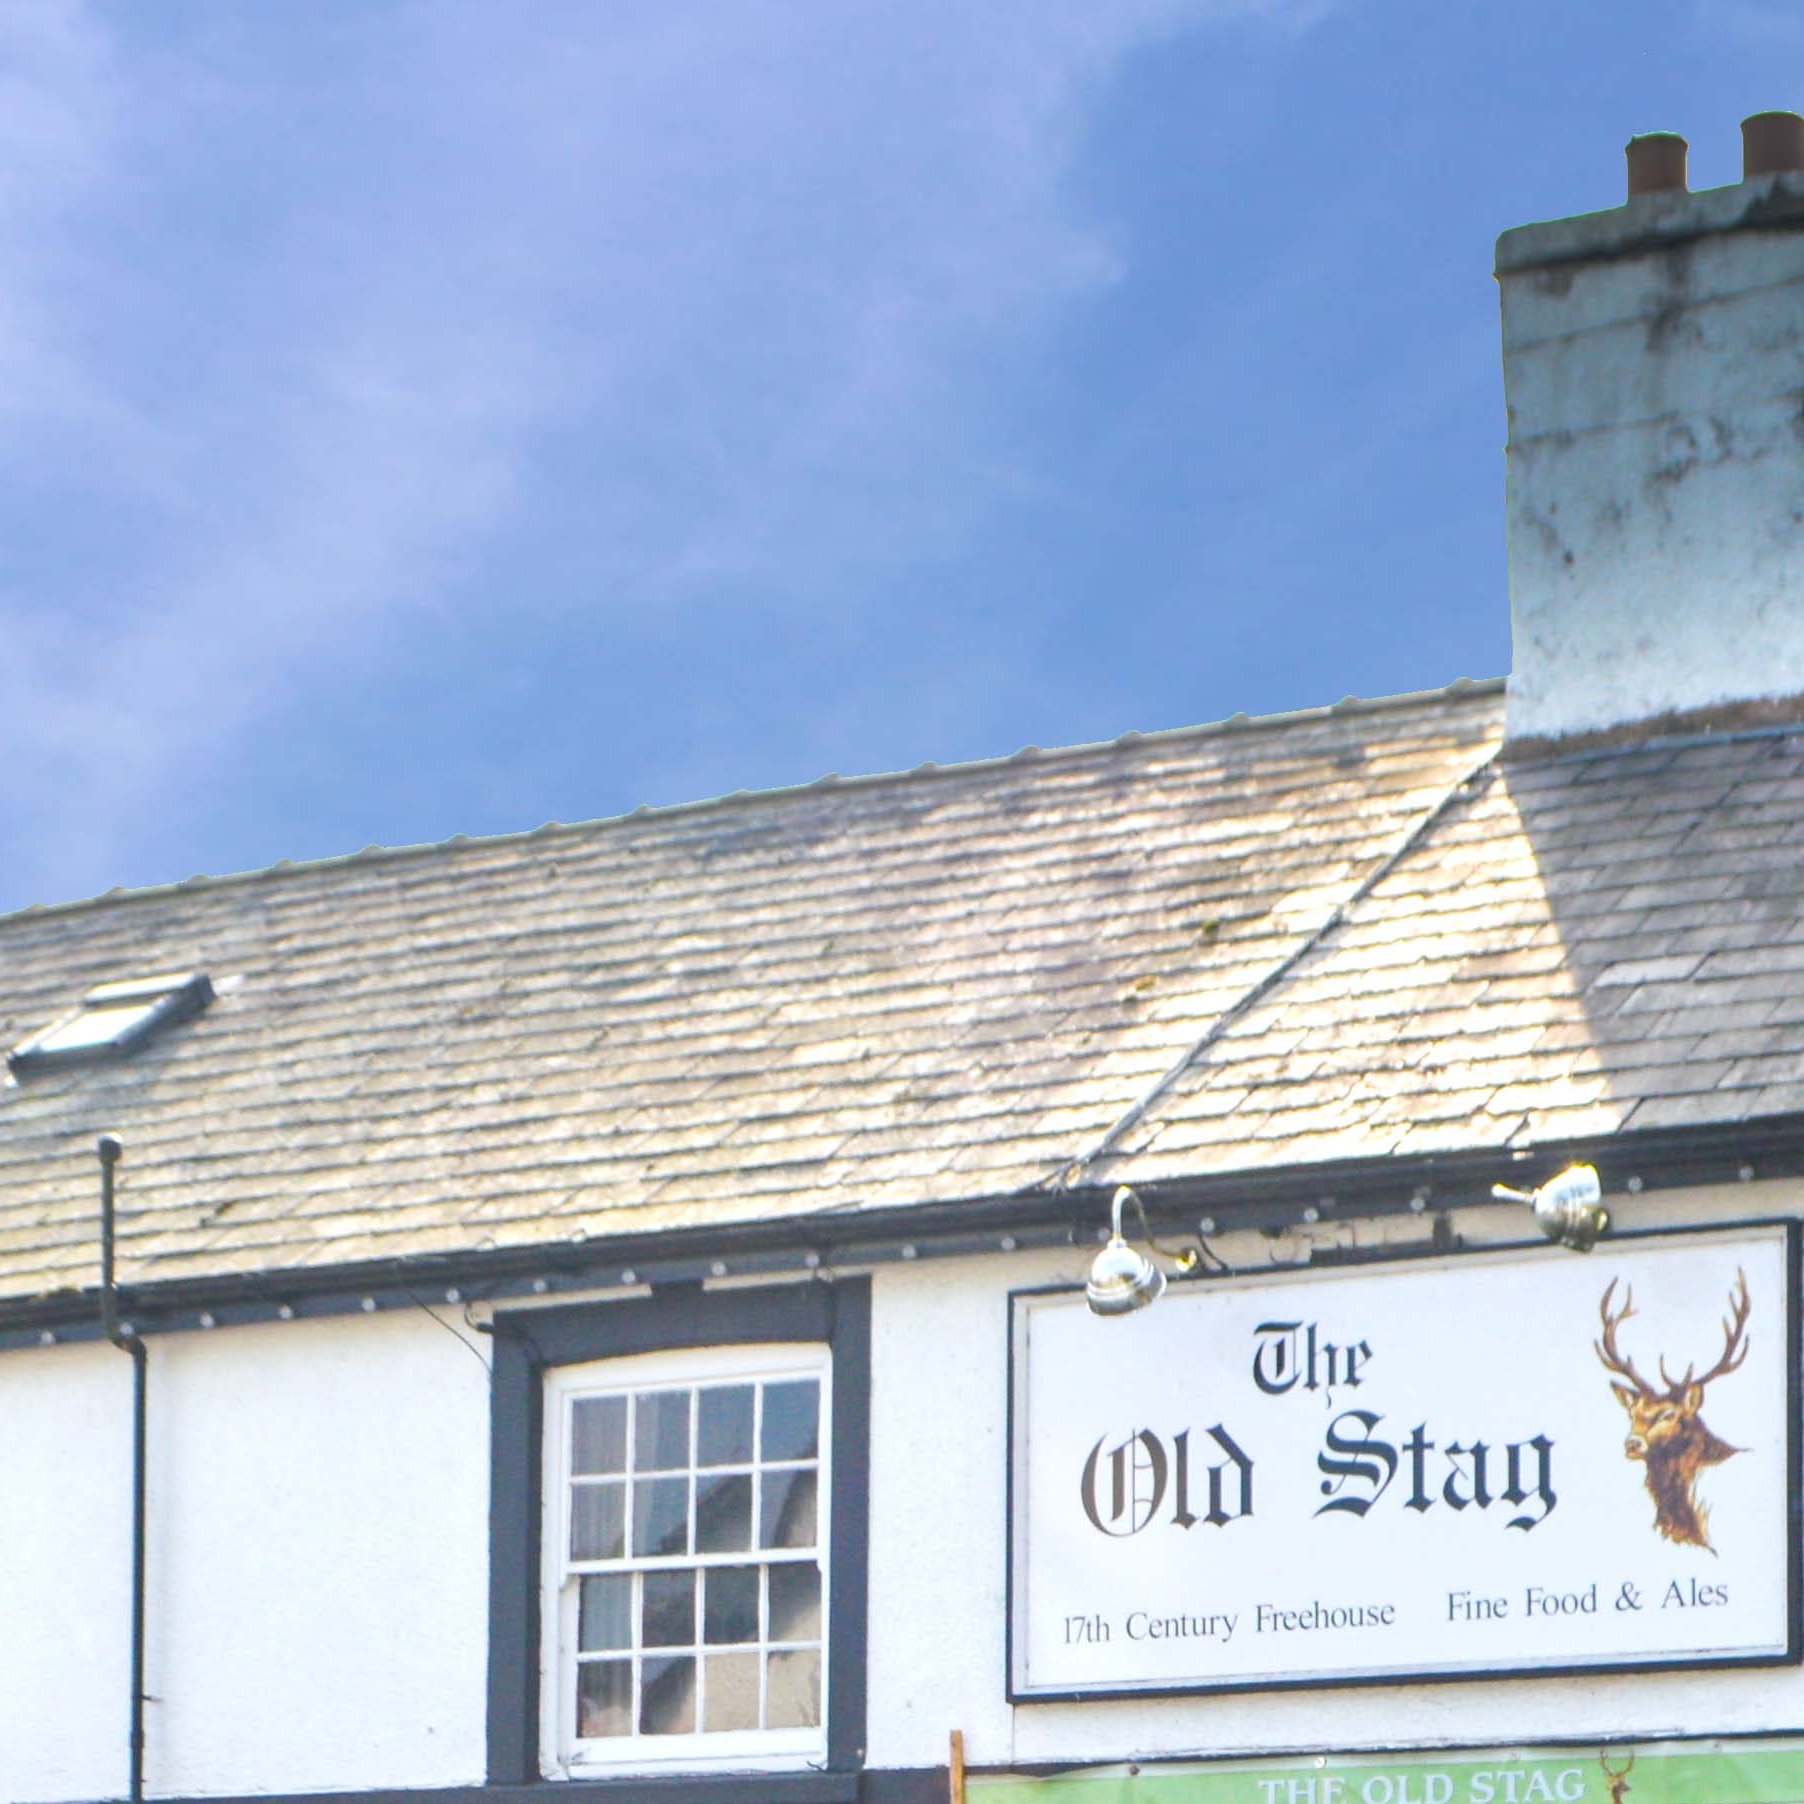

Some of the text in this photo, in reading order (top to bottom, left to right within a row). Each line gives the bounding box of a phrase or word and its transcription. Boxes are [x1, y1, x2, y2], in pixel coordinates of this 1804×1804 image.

[1253, 1320, 1374, 1408] The
[1080, 1410, 1557, 1538] Old Stag
[1063, 1577, 1729, 1645] 17th Century Freehouse Fine Food & Ales
